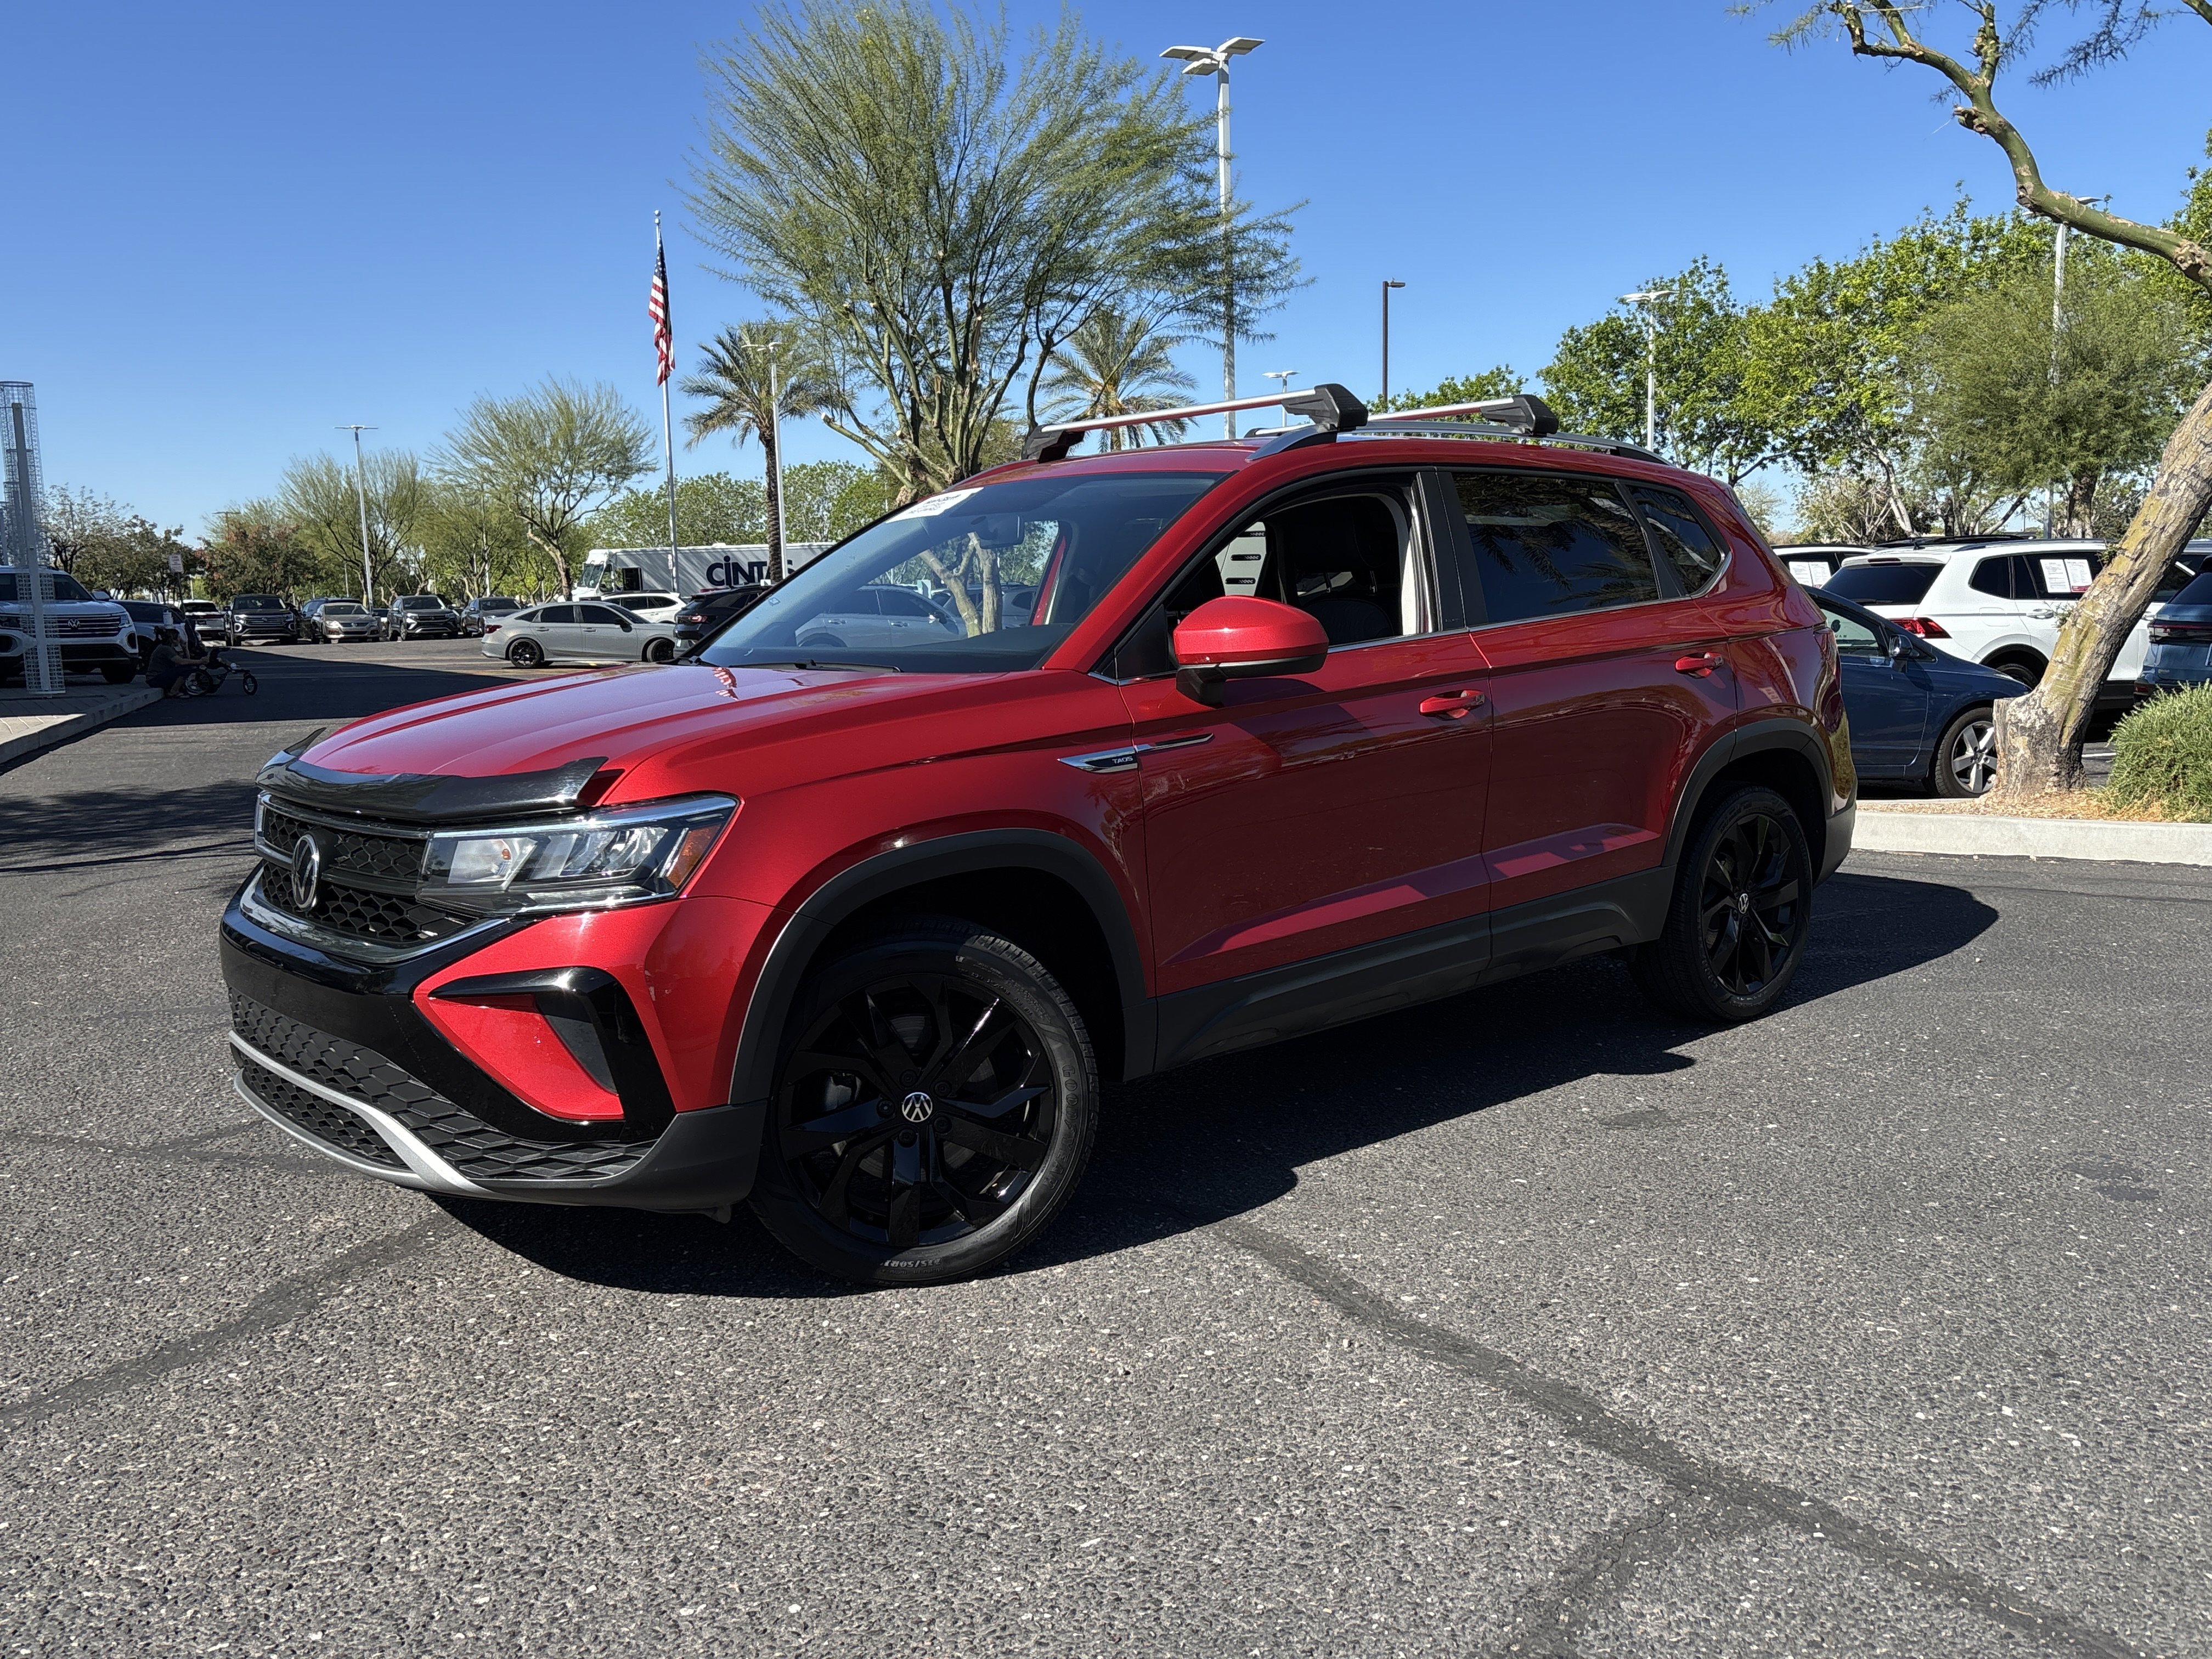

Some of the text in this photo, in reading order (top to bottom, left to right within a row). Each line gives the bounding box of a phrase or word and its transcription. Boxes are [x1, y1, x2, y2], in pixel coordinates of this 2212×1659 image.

[706, 555, 795, 586] CiNT
[1111, 756, 1134, 764] TAOS
[1042, 1065, 1080, 1189] GOODYEAR
